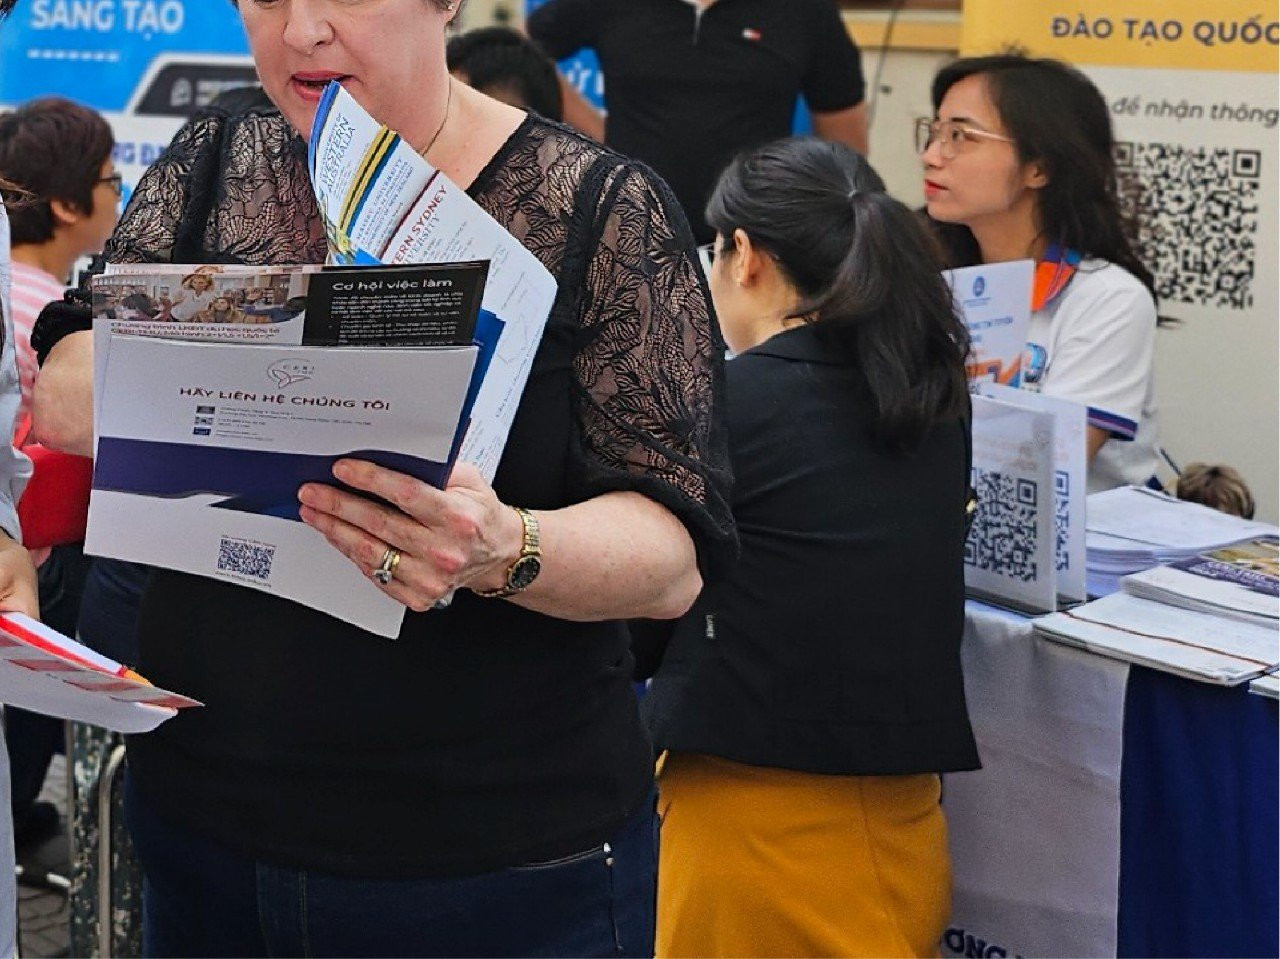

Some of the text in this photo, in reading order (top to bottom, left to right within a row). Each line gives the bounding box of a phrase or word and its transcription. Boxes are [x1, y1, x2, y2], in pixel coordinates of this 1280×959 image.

[1051, 13, 1113, 39] ĐÀO
[1124, 18, 1183, 46] TẠO
[321, 116, 349, 183] WESTERN
[410, 184, 448, 234] SYDNEY
[332, 279, 453, 291] Cơ hội việc làm
[180, 387, 390, 411] HÃY LIÊN HỆ CHÚNG TÔI
